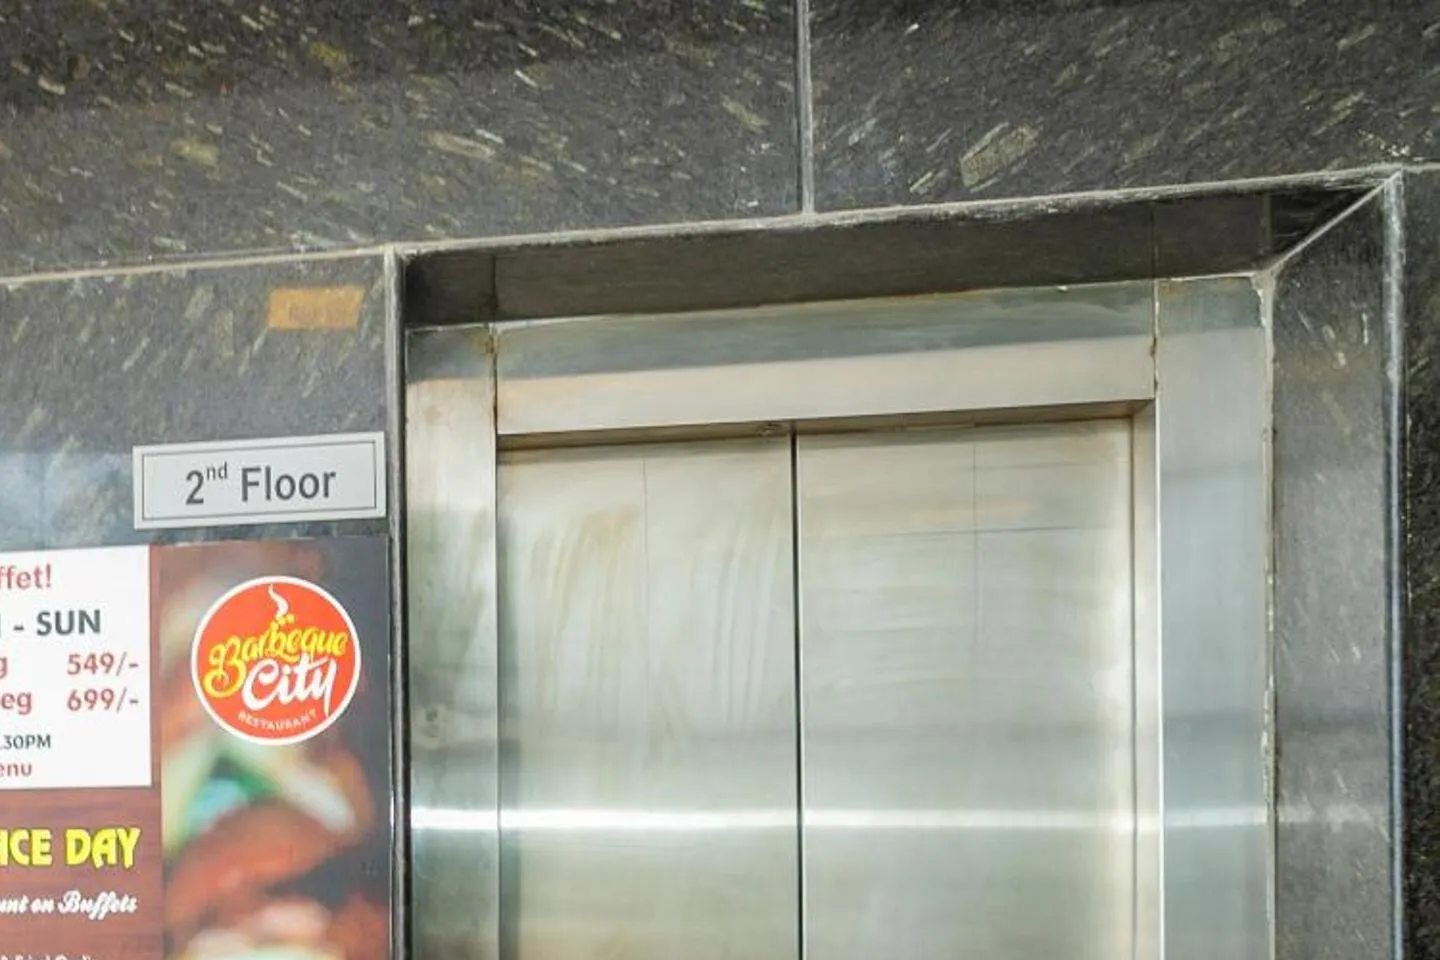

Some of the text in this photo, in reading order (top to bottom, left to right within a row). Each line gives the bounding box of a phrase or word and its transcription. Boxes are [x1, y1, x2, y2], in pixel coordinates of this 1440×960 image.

[185, 462, 336, 506] 2nd Floor
[36, 609, 101, 636] SUN
[67, 651, 138, 677] 549/-
[203, 622, 348, 698] Barbeque
[242, 653, 337, 718] City
[67, 687, 138, 714] 699/-
[238, 709, 317, 731] RESTAURANT
[66, 827, 141, 869] DAY
[30, 897, 54, 912] on
[58, 890, 137, 919] Buffets
